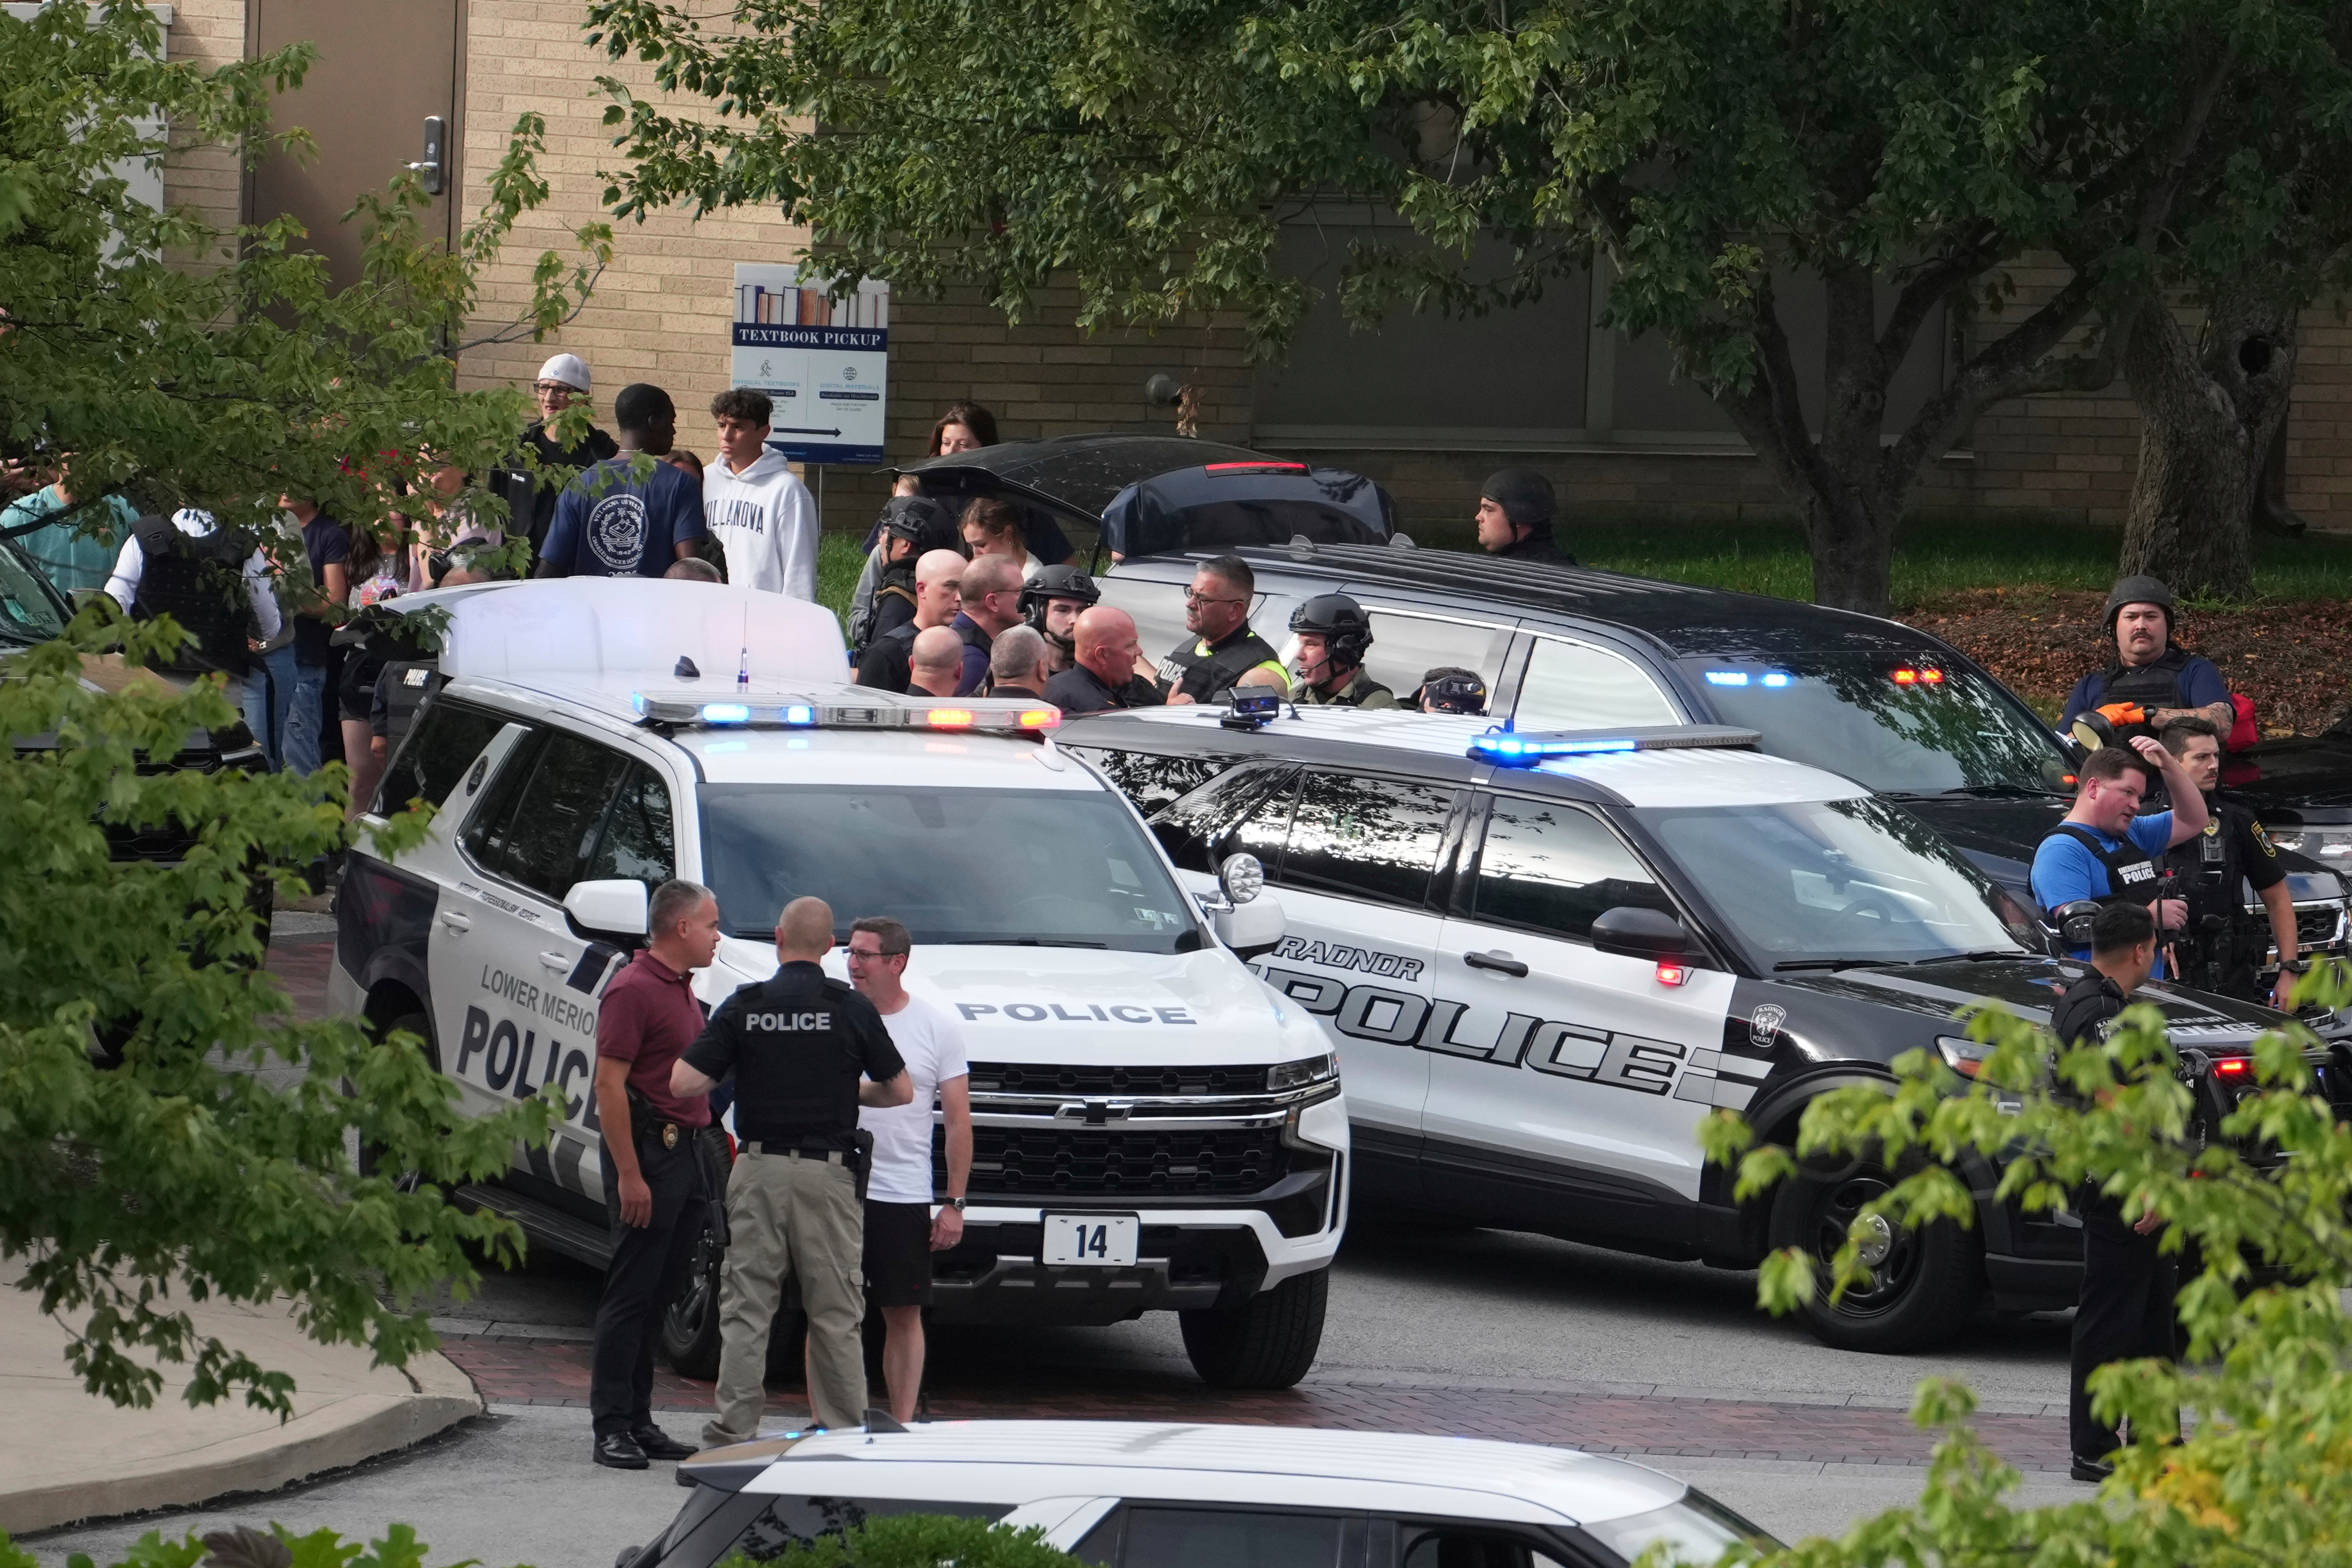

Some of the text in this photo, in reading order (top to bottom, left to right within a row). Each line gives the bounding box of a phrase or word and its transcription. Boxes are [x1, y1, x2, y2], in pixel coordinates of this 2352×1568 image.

[739, 329, 881, 345] TEXTBOOK PICKUP
[594, 499, 644, 522] VILLANOVA UNIVERSI
[403, 668, 428, 686] POLICE
[1155, 658, 1187, 683] POLICE
[2122, 867, 2156, 885] POLICE
[1271, 935, 1424, 982] RADNOR
[481, 964, 597, 1039] LOWER MERIO
[954, 1003, 1197, 1025] POLICE
[1758, 1006, 1784, 1017] RADNOR
[2163, 1016, 2228, 1025] ADNOR
[746, 1012, 831, 1031] POLICE
[1262, 966, 1687, 1096] POLICE
[2162, 1021, 2268, 1036] OLICE
[1753, 1035, 1771, 1044] POLICE
[1076, 1224, 1107, 1258] 14
